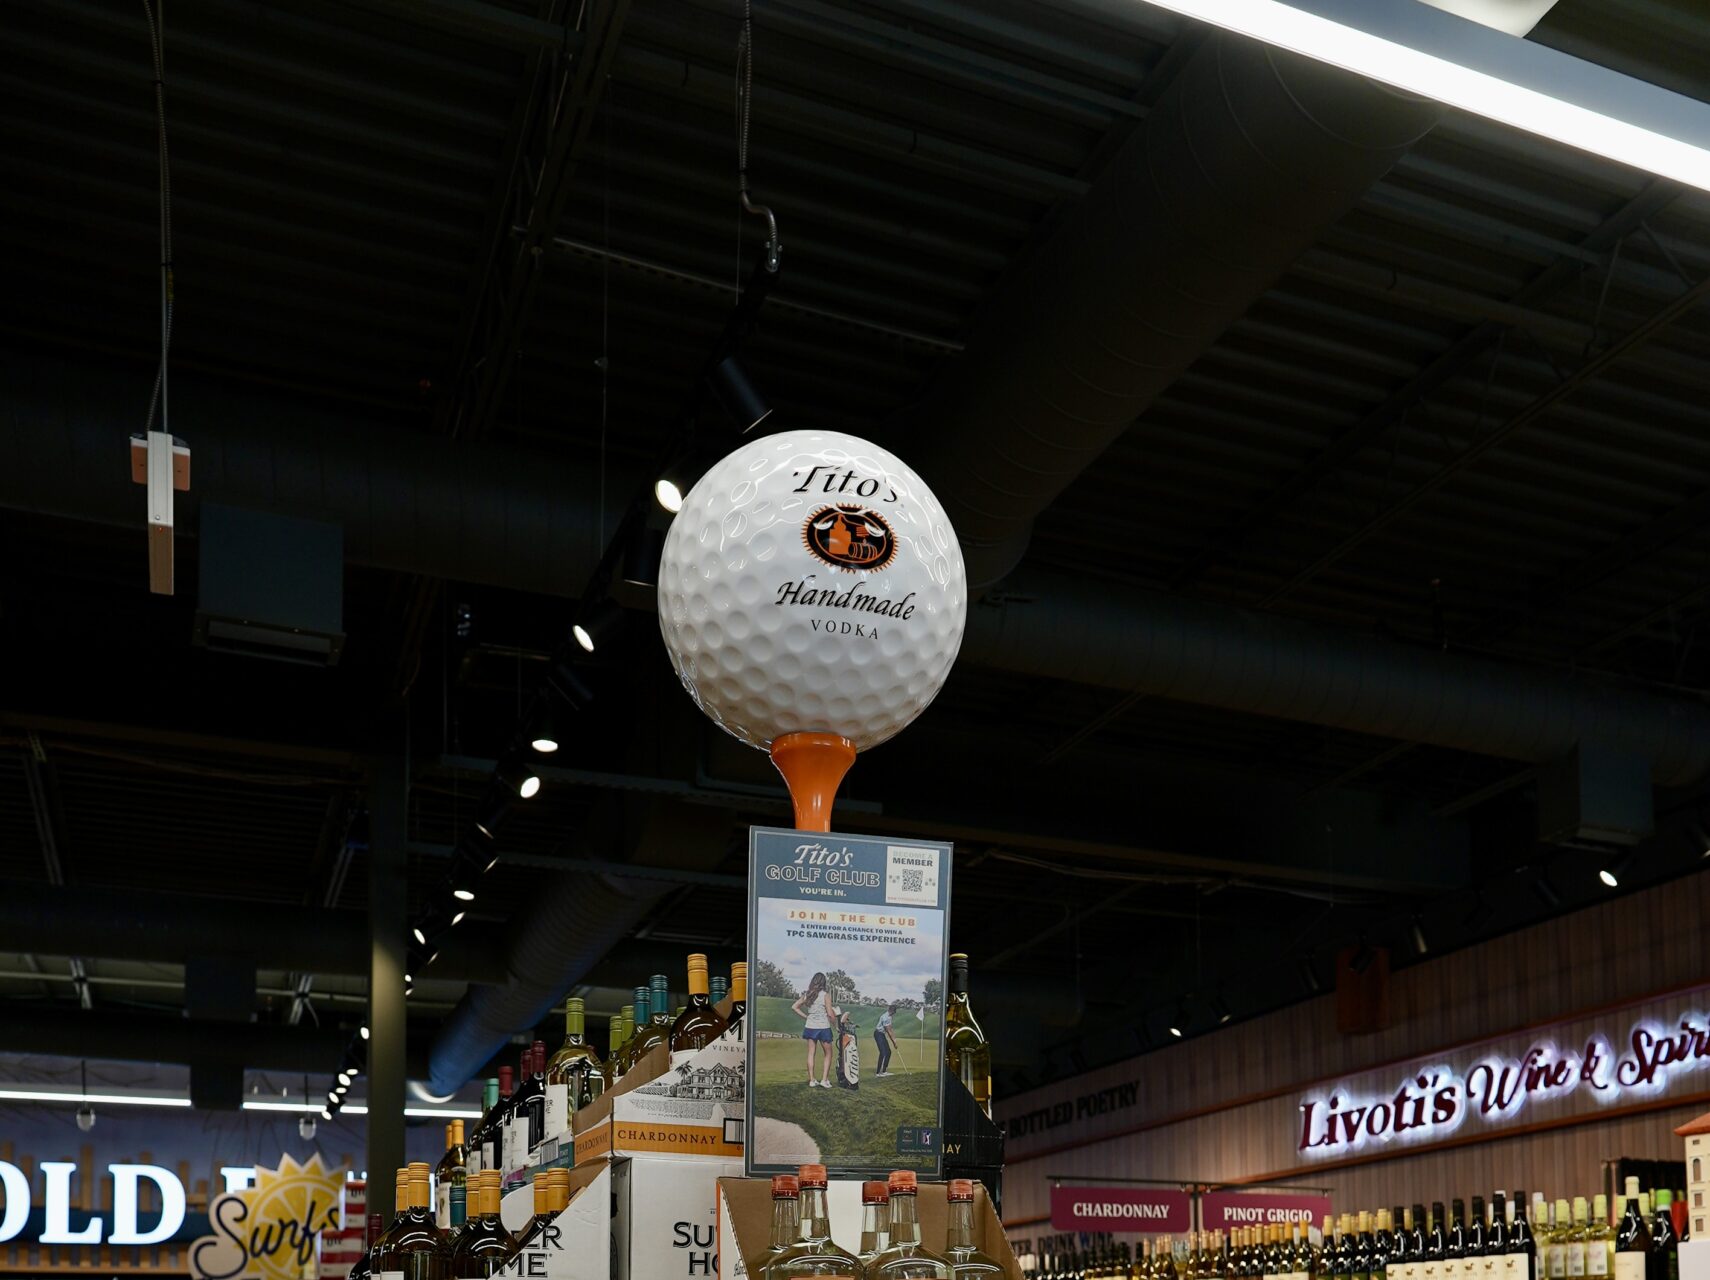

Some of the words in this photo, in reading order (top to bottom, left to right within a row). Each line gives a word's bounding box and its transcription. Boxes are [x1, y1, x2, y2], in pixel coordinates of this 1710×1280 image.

[792, 465, 898, 503] Tito's
[775, 575, 915, 621] Handmade
[810, 619, 879, 639] VODKA
[794, 843, 853, 867] Tito's
[892, 857, 933, 867] MEMBER
[765, 865, 821, 883] GOLF
[825, 868, 880, 887] CLUB
[800, 886, 833, 896] YOU'RE
[834, 889, 847, 897] IN.
[789, 911, 827, 921] JOIN
[840, 914, 866, 924] THE
[878, 916, 917, 926] CLUB
[786, 930, 805, 938] TPC
[806, 931, 859, 942] SAWGRASS
[859, 935, 917, 946] EXPERIENCE
[1076, 1080, 1140, 1118] POETRY
[1300, 1074, 1457, 1151] Livoti's
[1466, 1048, 1570, 1116] Wine
[1581, 1042, 1608, 1090] &
[618, 1129, 717, 1144] CHARDONNAY
[1072, 1201, 1170, 1219] CHARDONNAY
[1223, 1206, 1265, 1222] PINOT
[1267, 1208, 1313, 1223] GRIGIO
